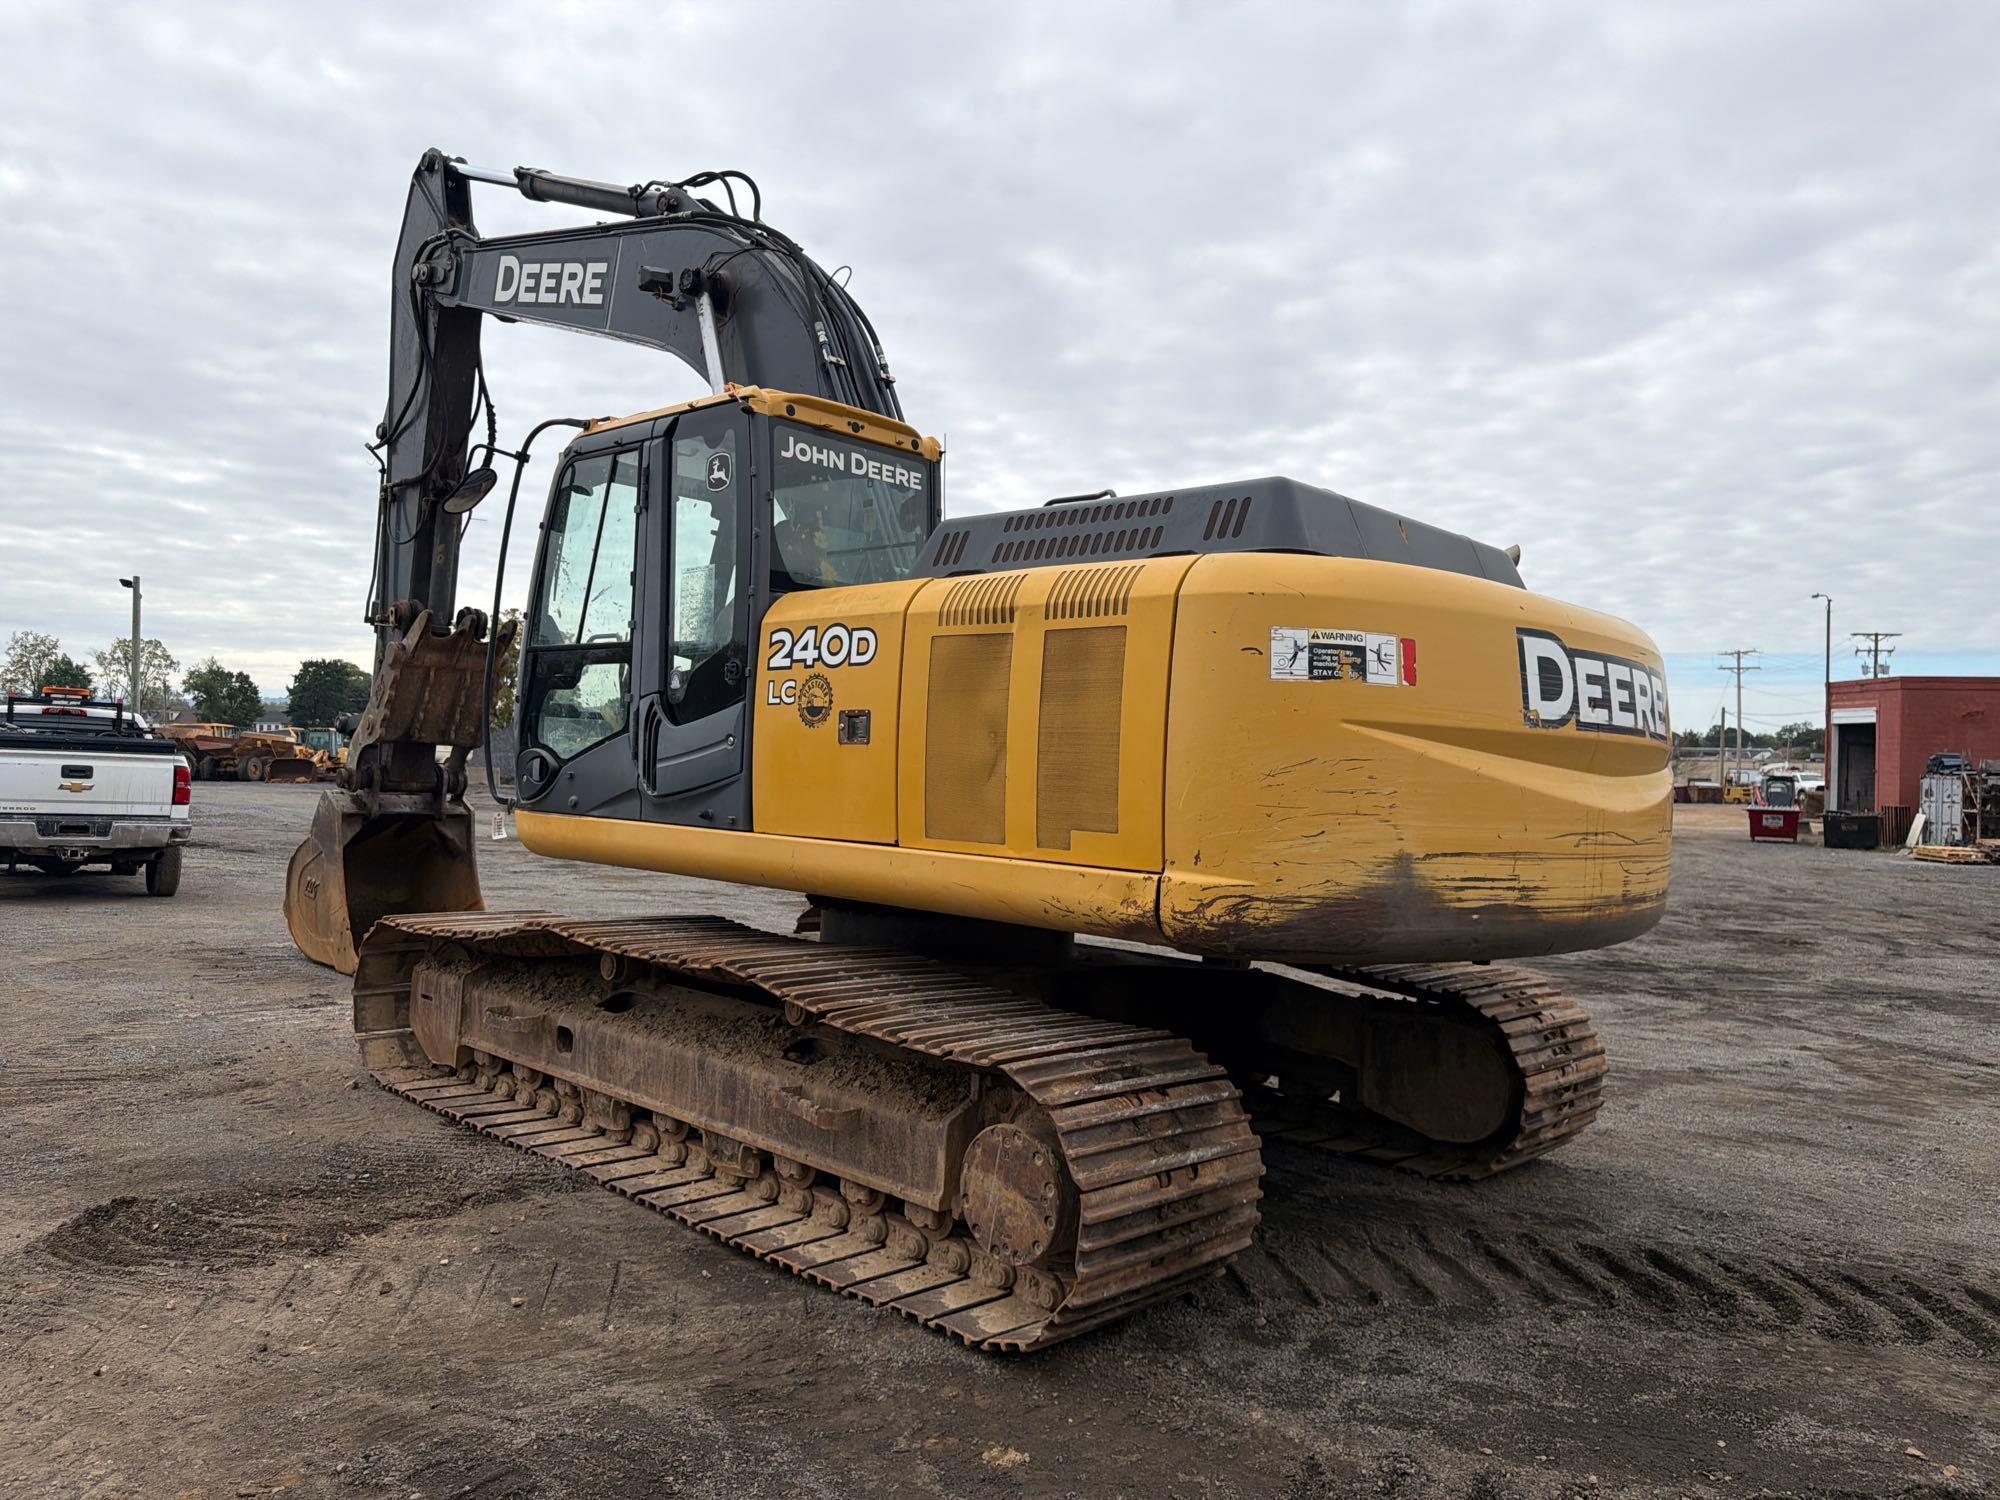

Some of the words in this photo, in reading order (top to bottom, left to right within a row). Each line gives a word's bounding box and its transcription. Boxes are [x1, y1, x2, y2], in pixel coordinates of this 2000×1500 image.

[494, 255, 608, 305] DEERE
[781, 436, 845, 471] JOHN
[851, 452, 922, 490] DEERE
[767, 623, 878, 671] 240D
[1320, 631, 1363, 642] WARNING
[767, 679, 798, 705] LC
[1520, 634, 1668, 739] DEERE
